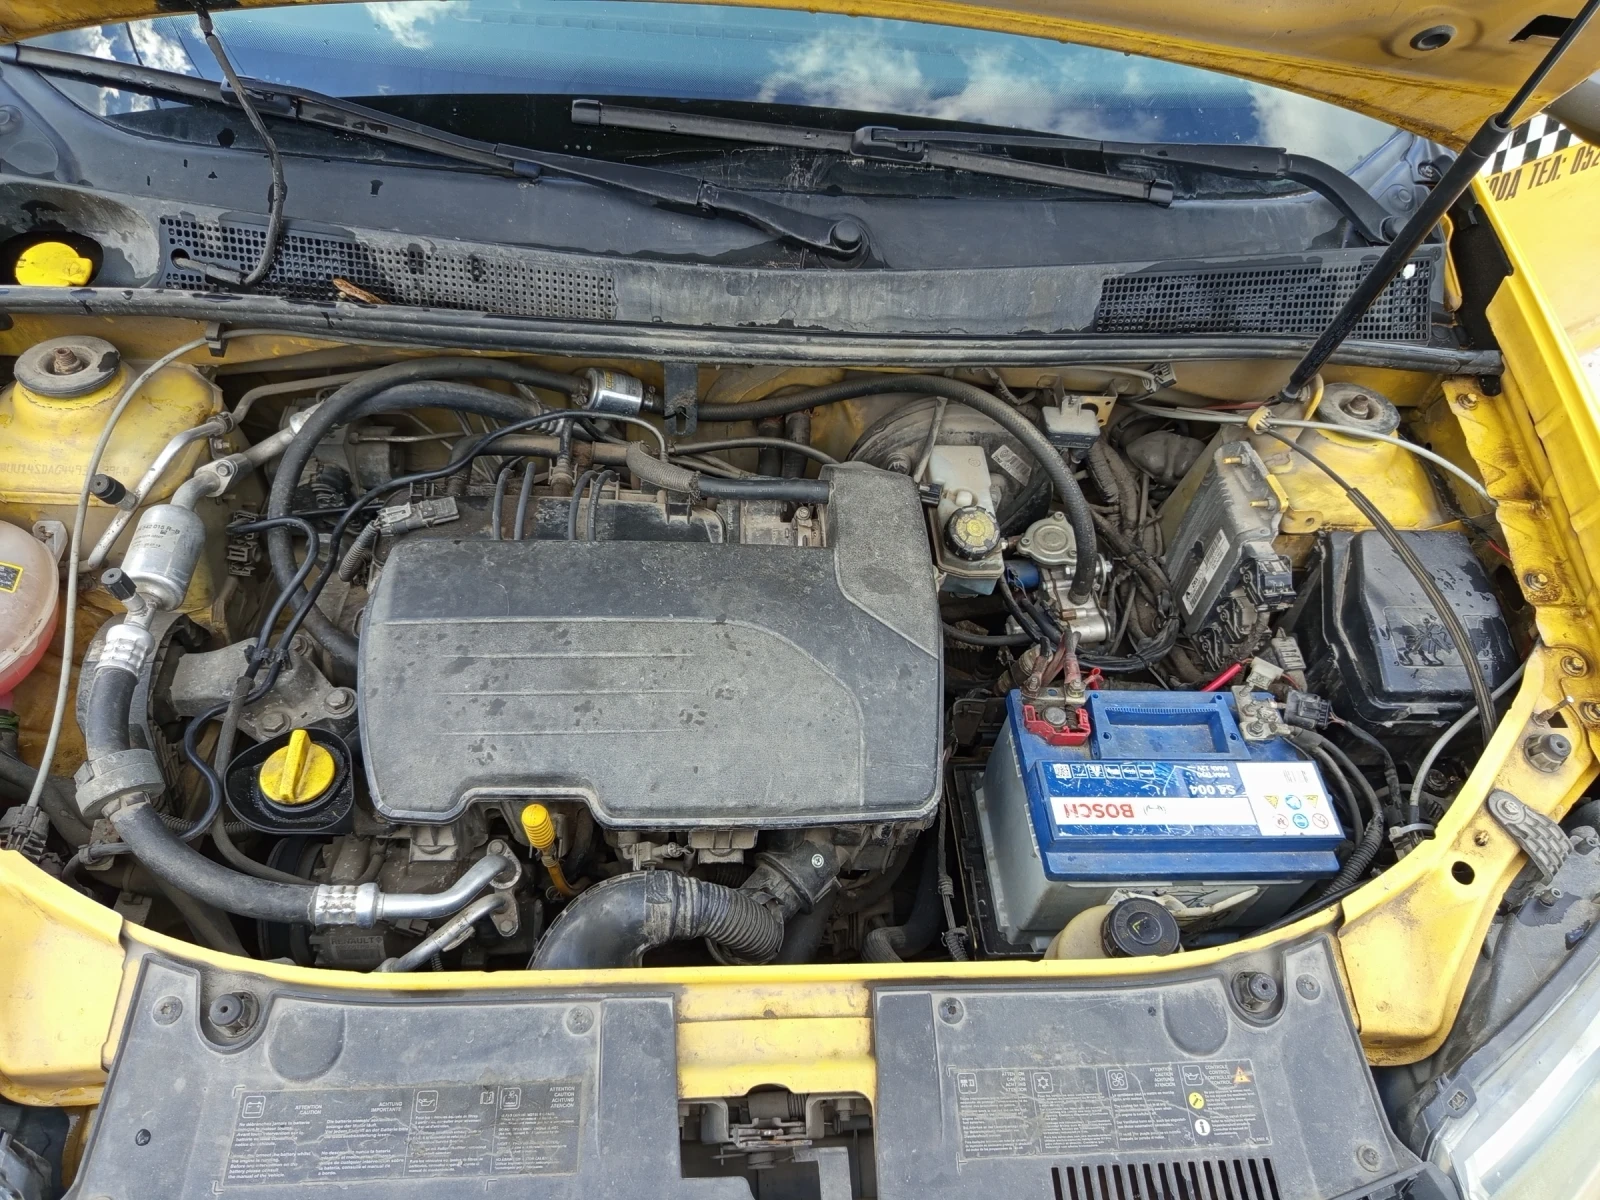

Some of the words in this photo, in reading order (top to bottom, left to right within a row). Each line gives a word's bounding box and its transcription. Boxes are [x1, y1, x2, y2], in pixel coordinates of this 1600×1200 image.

[1189, 784, 1216, 796] 004
[1217, 784, 1236, 796] S4
[1063, 803, 1135, 818] BOSCH
[331, 937, 374, 945] RENAULT
